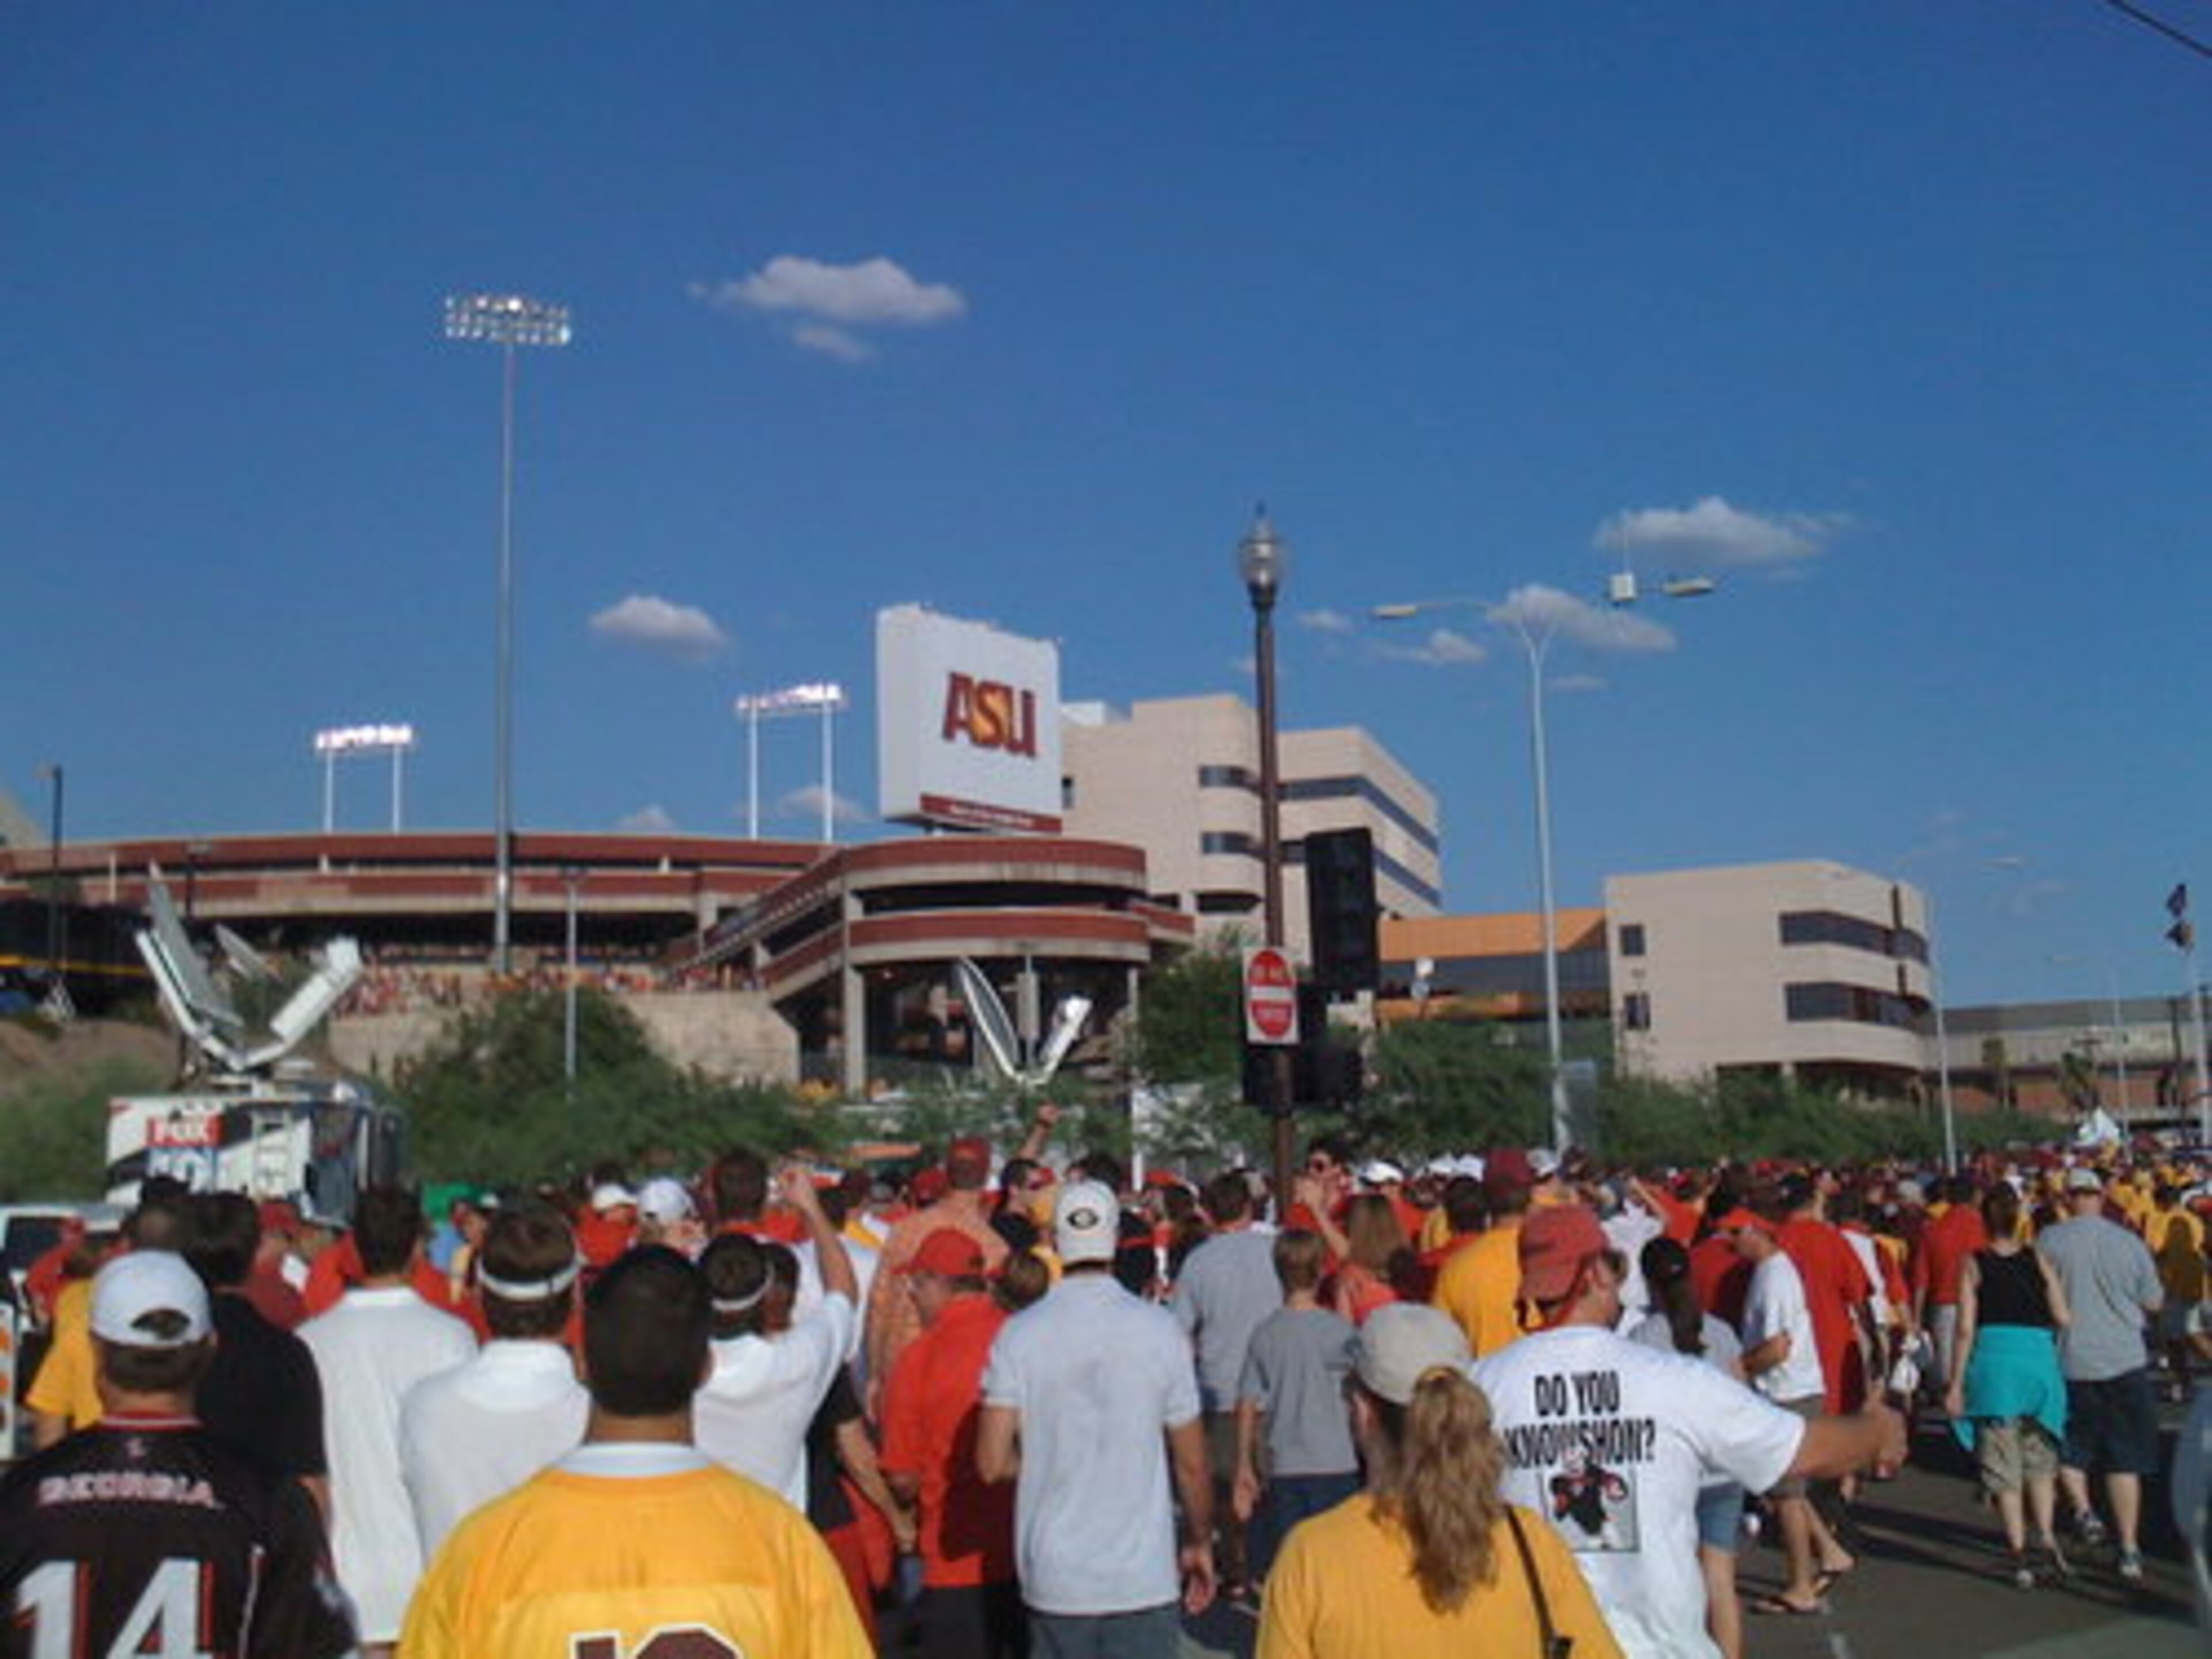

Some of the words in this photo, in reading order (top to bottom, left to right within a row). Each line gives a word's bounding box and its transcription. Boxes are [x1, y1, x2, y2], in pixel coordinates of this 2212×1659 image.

[942, 672, 1036, 757] ASU
[1535, 1374, 1567, 1416] DO
[1571, 1371, 1619, 1415] YOU
[16, 1559, 215, 1659] 14
